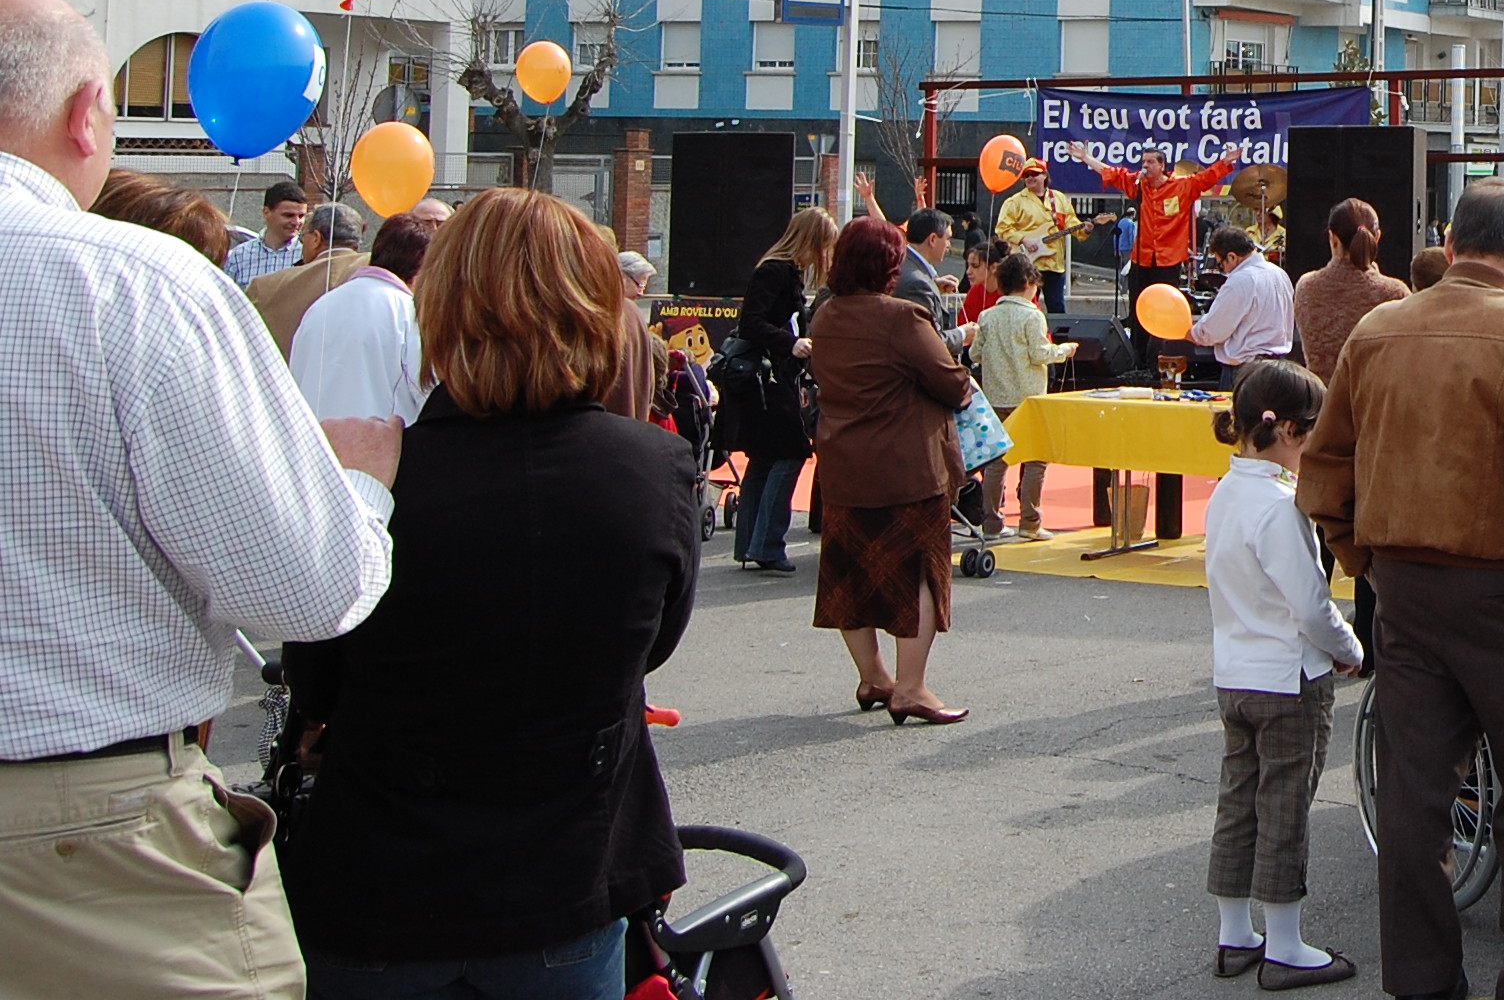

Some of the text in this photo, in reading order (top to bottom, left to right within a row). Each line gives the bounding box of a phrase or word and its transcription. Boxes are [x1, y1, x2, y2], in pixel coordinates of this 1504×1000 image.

[1043, 99, 1262, 130] El teu vot farà
[660, 306, 738, 318] AMB ROVELL D'OU
